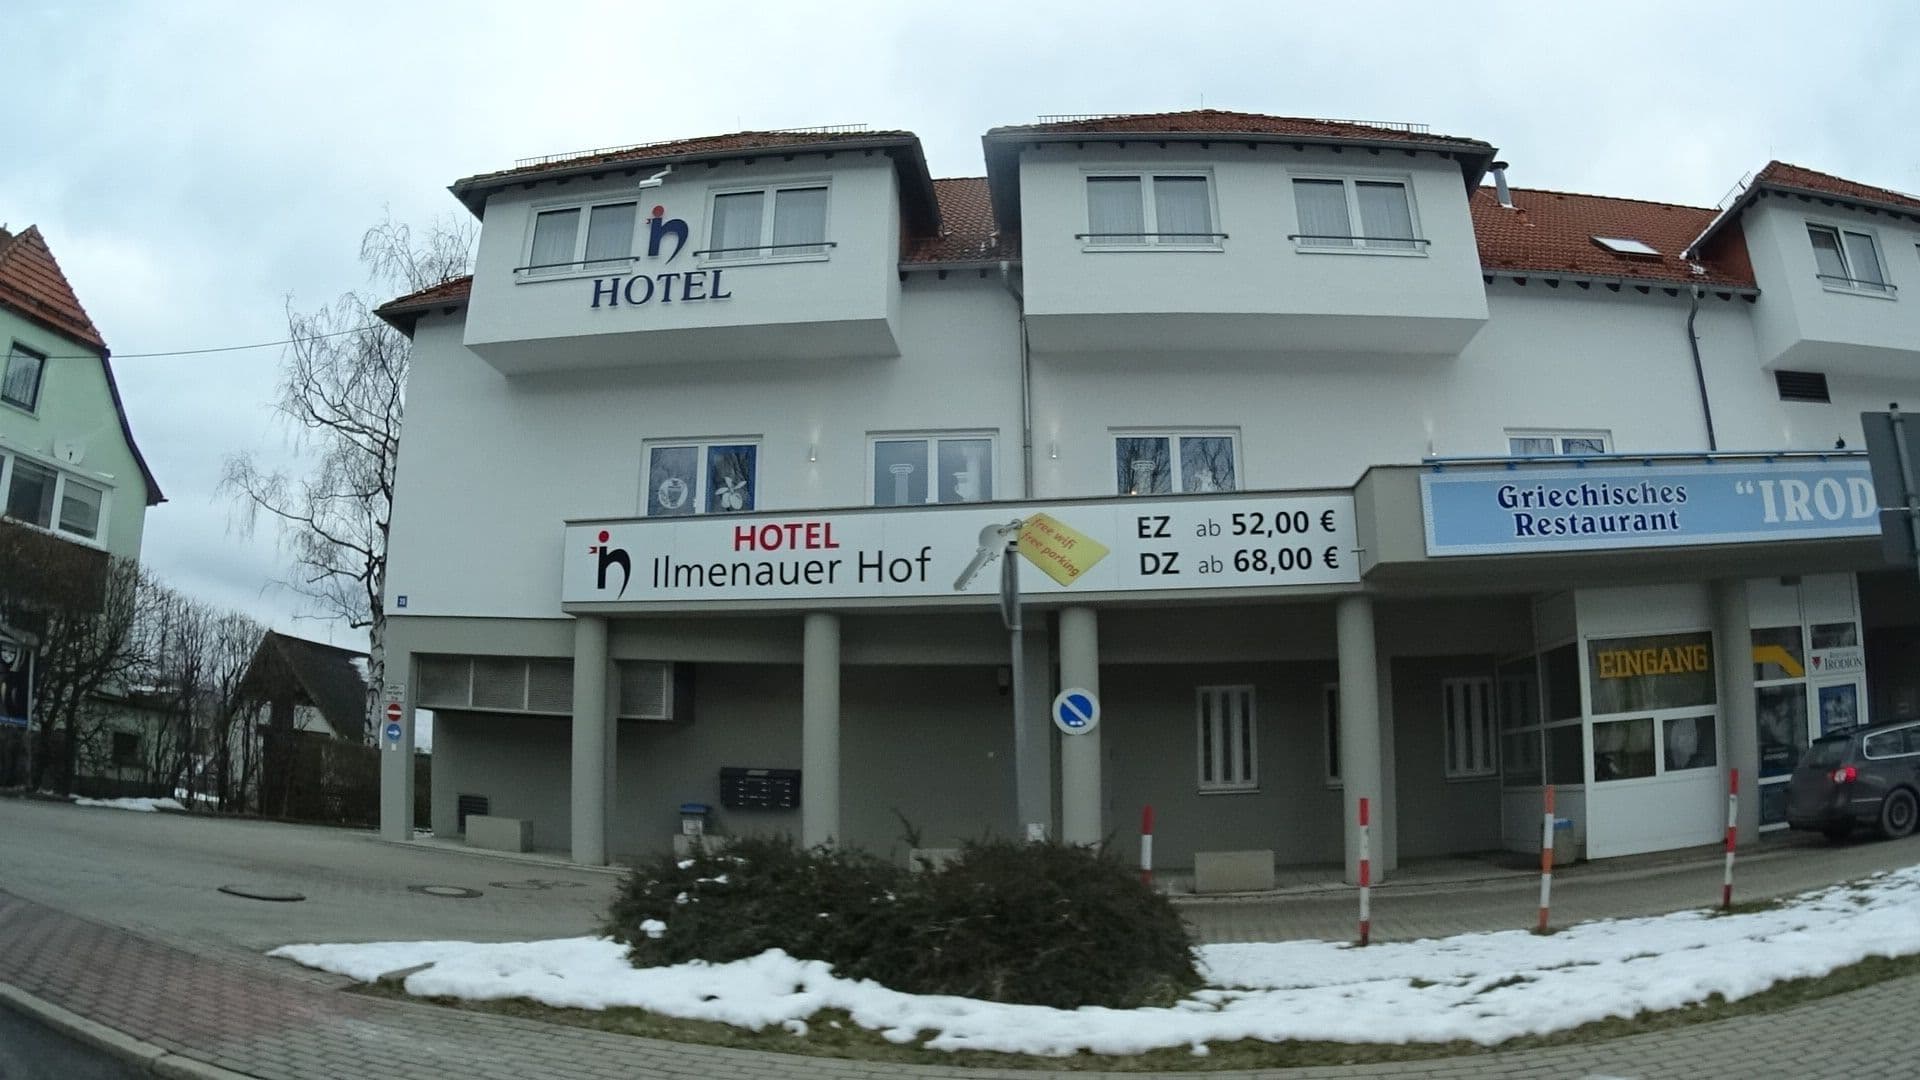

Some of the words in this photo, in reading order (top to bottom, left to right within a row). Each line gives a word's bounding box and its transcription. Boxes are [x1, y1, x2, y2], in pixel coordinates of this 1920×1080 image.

[590, 269, 732, 308] HOTEL
[1497, 481, 1688, 510] Griechisches
[733, 522, 840, 552] HOTEL
[1137, 516, 1171, 539] EZ
[1196, 518, 1222, 538] ab
[1231, 511, 1310, 539] 52,00
[1320, 509, 1337, 533] €
[1514, 509, 1681, 537] Restaurant
[653, 555, 842, 588] Ilmenauer
[857, 546, 932, 583] Hof
[1040, 547, 1080, 577] parking
[1140, 552, 1180, 575] DZ
[1198, 555, 1224, 575] ab
[1233, 547, 1313, 575] 68,00
[1323, 546, 1340, 570] €
[1598, 644, 1708, 679] EINGANG
